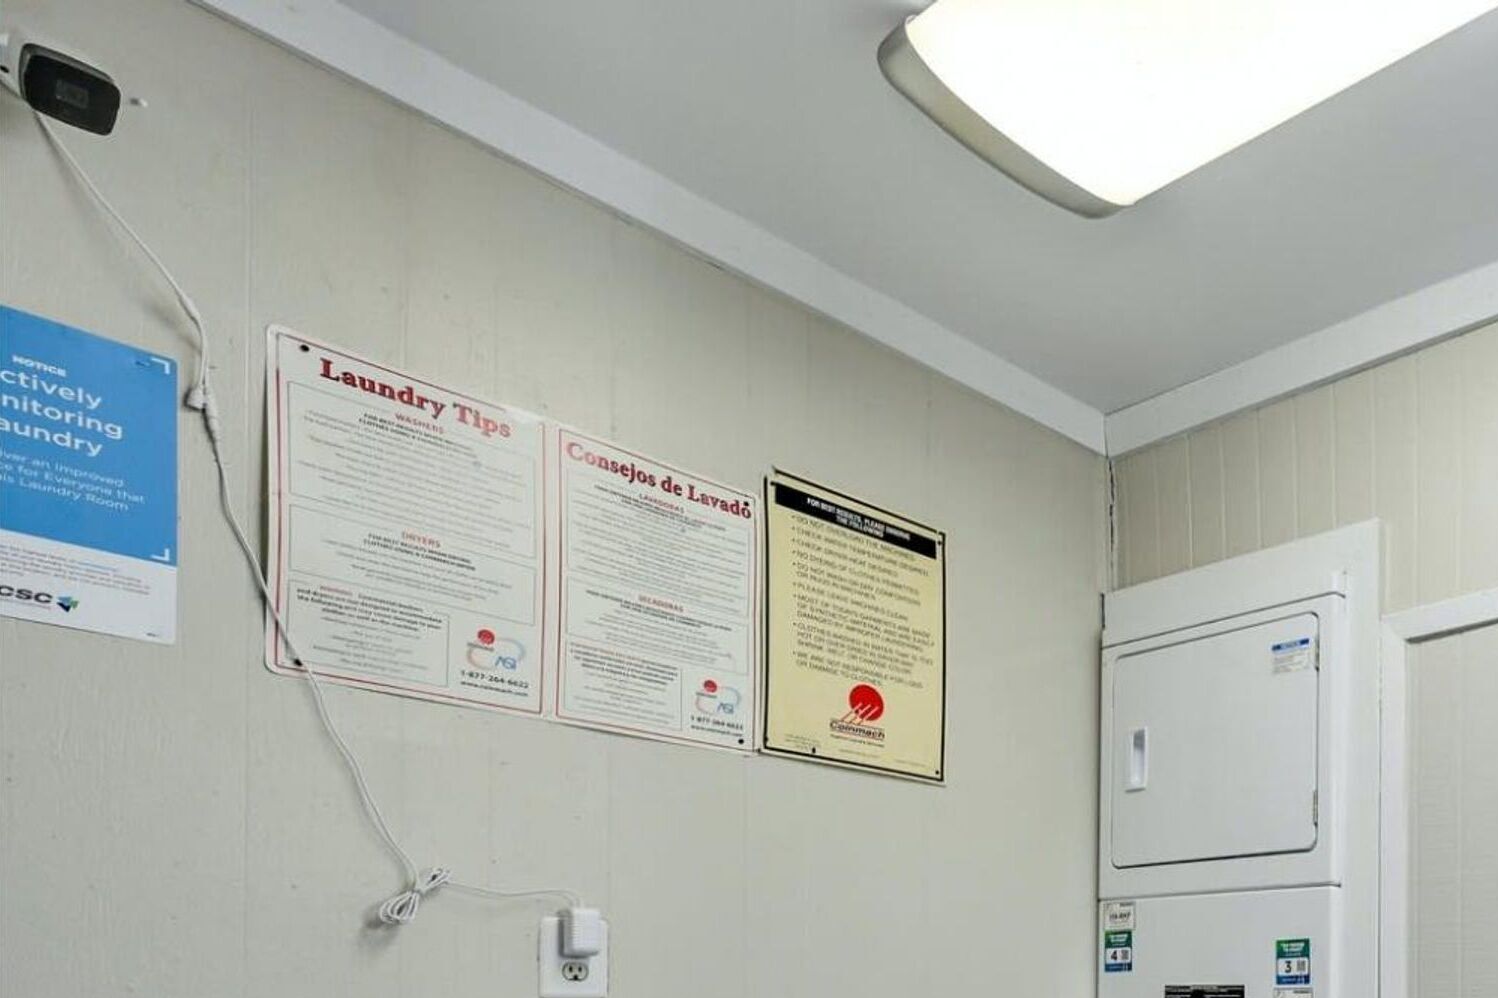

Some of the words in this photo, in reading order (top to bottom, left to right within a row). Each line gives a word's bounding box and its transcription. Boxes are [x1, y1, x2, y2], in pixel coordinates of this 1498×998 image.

[12, 354, 67, 377] NOTICE
[320, 357, 446, 419] Laundry
[452, 402, 511, 438] Tips
[567, 441, 656, 488] Consejos
[661, 476, 683, 497] de
[0, 585, 53, 604] CSC
[1110, 949, 1118, 961] 4
[1284, 960, 1292, 974] 3
